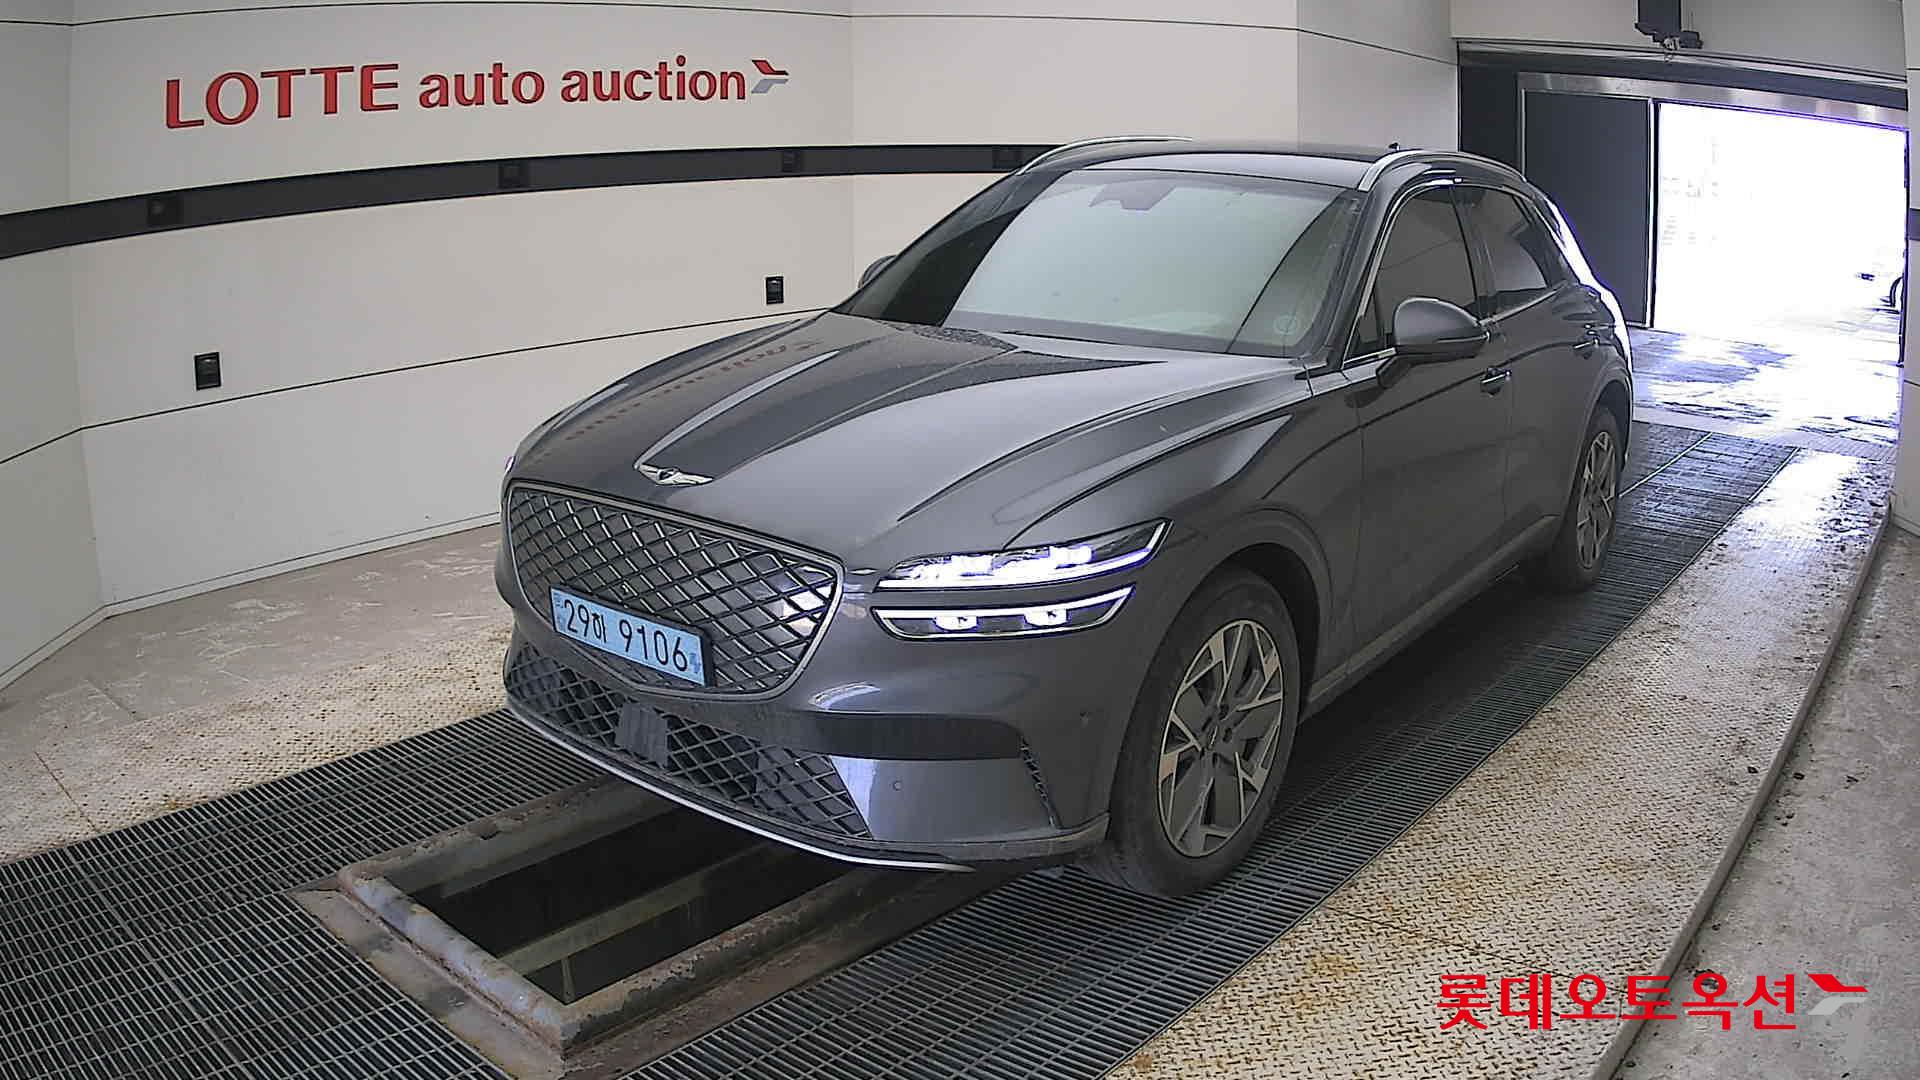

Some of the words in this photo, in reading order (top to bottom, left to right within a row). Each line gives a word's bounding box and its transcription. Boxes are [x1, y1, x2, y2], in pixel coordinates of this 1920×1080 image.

[165, 63, 399, 129] LOTTE
[418, 62, 546, 109] auto
[560, 55, 748, 103] auction
[564, 599, 607, 643] 29하
[619, 619, 687, 672] 9106
